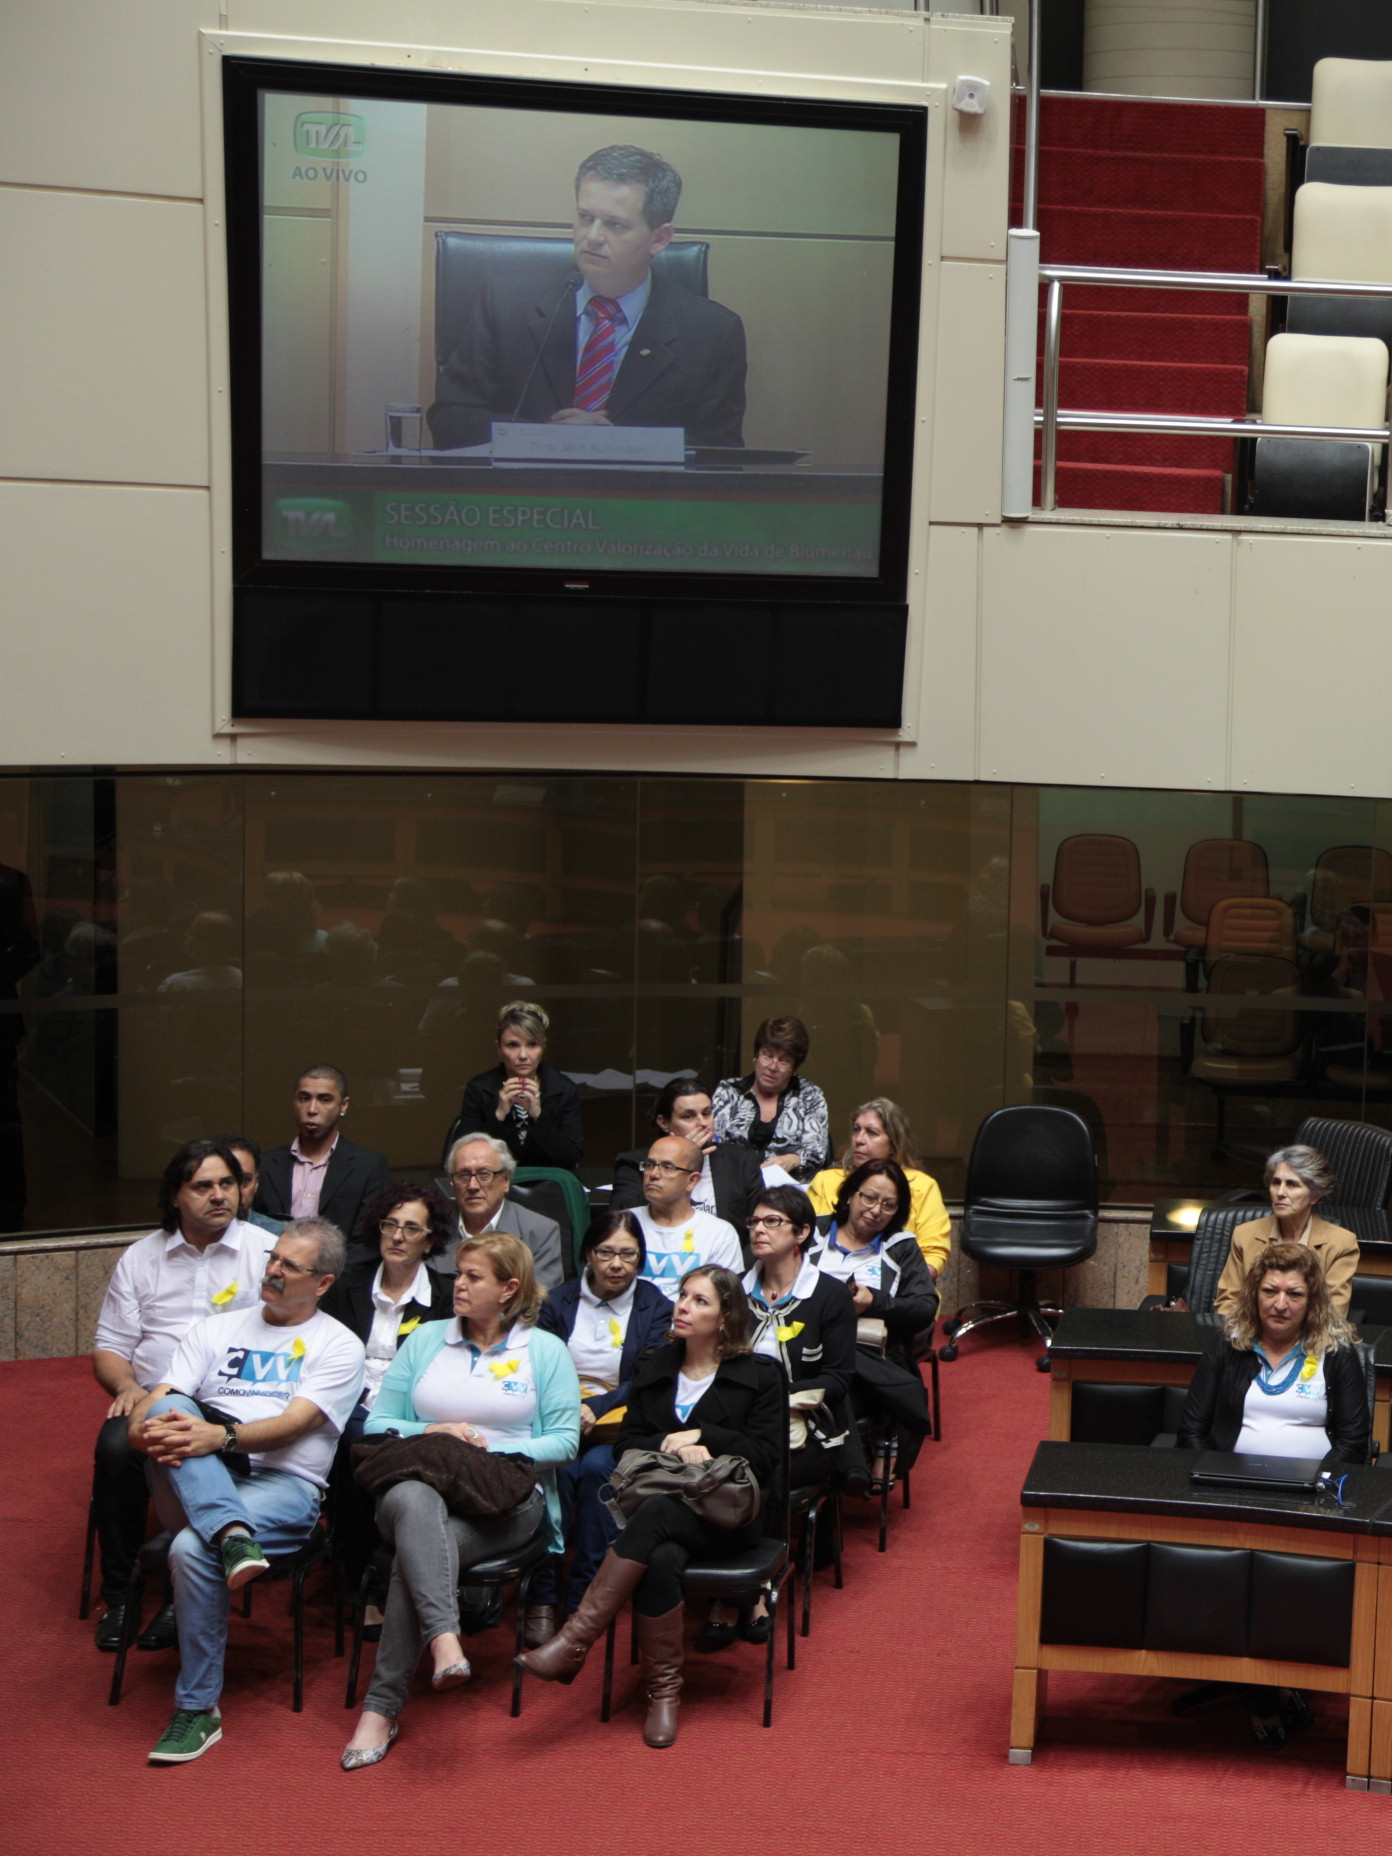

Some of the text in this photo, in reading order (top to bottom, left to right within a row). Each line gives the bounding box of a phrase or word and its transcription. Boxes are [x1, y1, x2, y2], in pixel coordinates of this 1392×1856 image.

[292, 166, 368, 184] AO VIVO
[385, 501, 600, 531] SESSÃO ESPECIAL
[385, 533, 872, 561] Homenagem ao Centro Valorização da Vida de Blumenau
